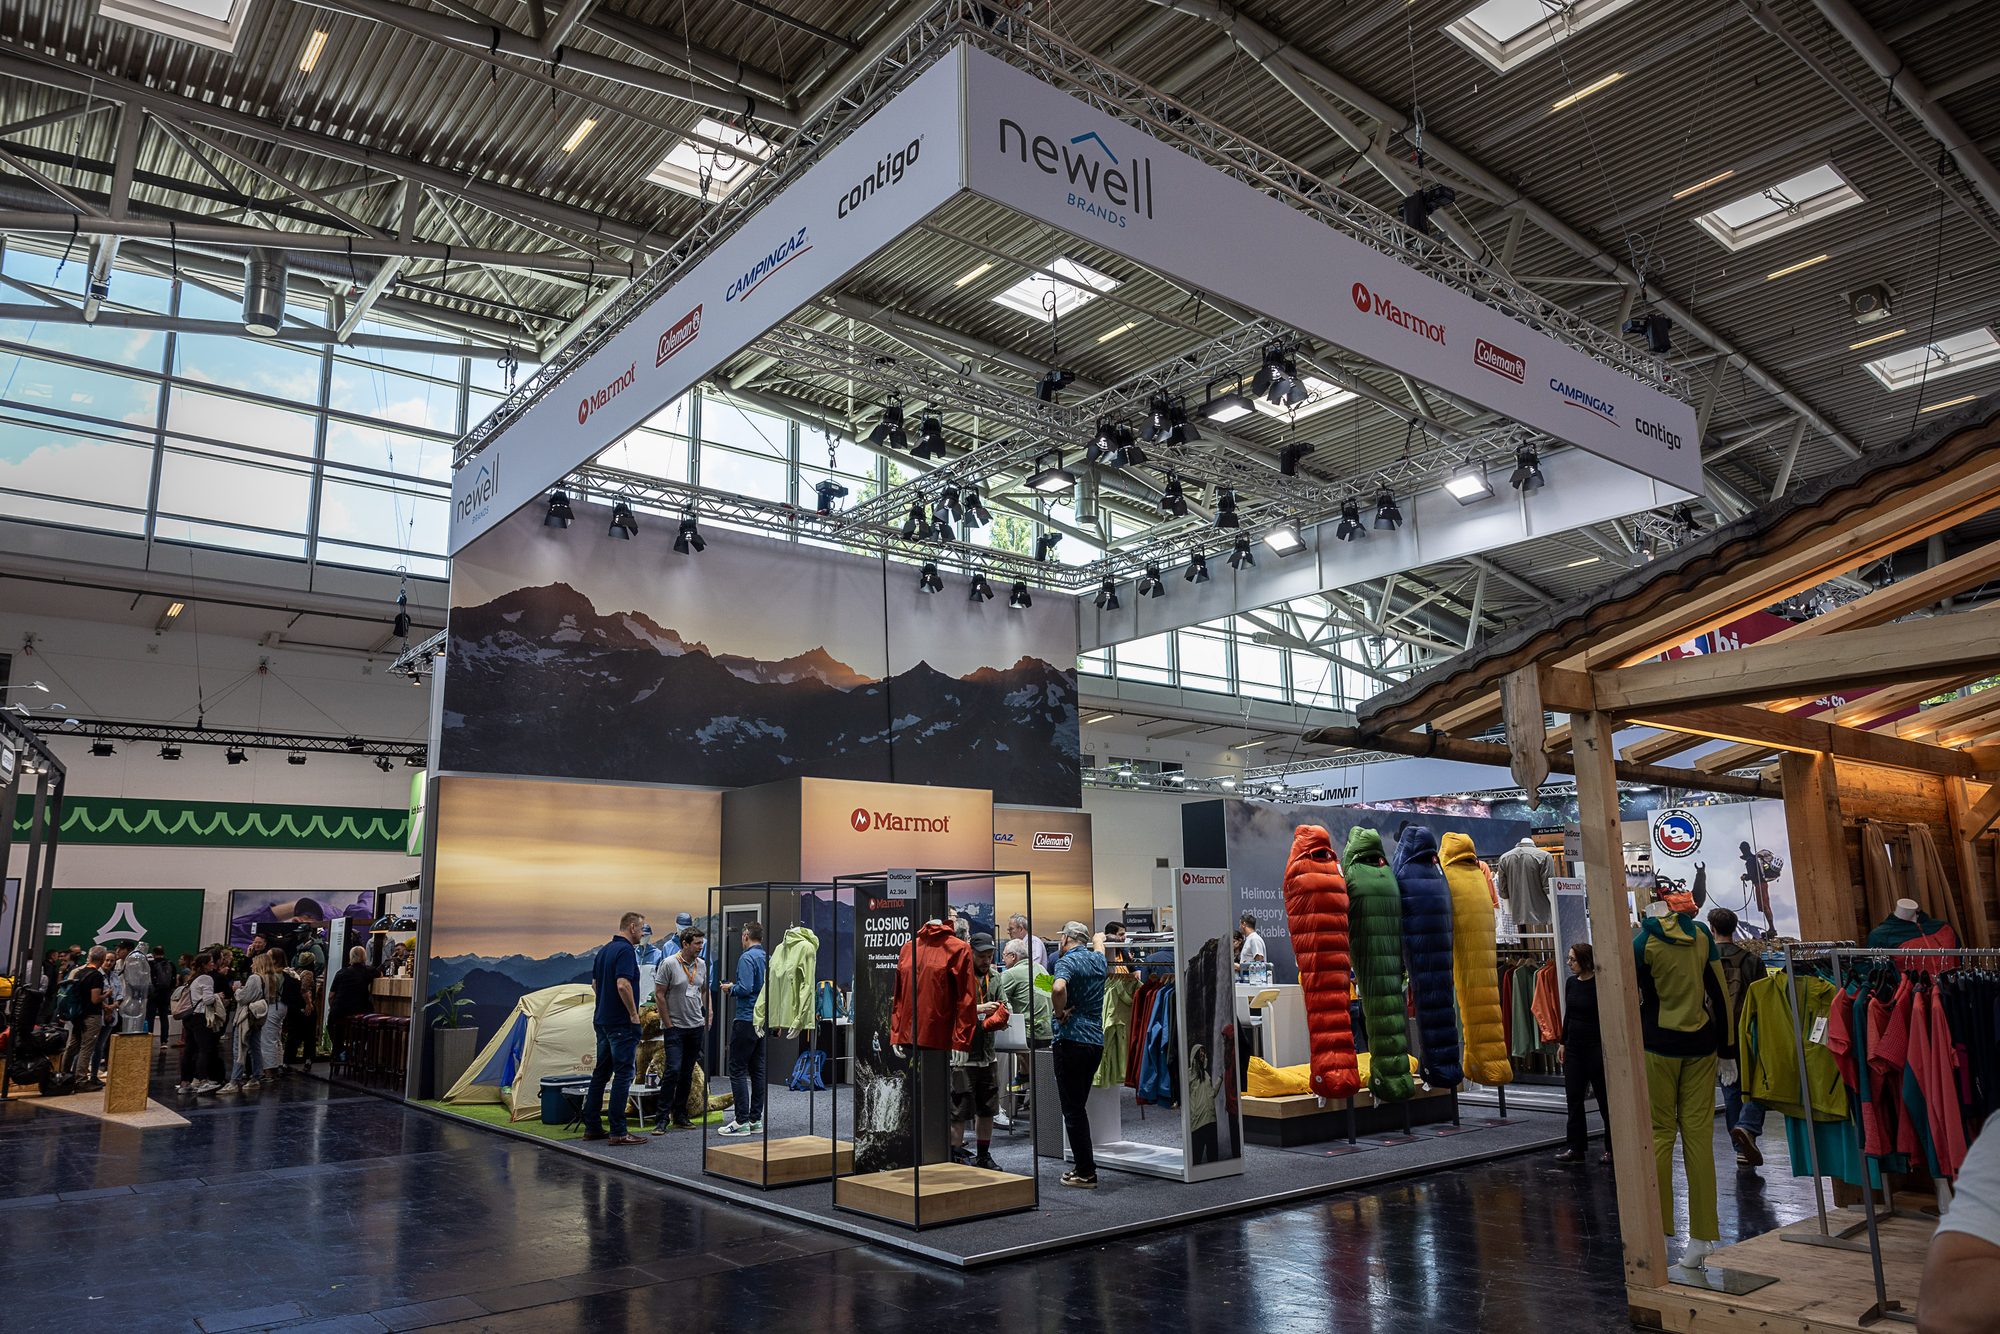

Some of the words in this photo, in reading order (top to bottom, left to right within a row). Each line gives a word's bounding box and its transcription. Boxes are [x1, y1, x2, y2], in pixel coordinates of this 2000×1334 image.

[1000, 118, 1153, 220] newell
[1066, 192, 1127, 229] BRANDS
[725, 226, 808, 302] CAMPINGAZ
[1373, 292, 1447, 346] Marmot
[659, 320, 693, 358] Coleman
[1477, 342, 1516, 374] Coleman
[589, 361, 637, 416] Marmot
[1549, 378, 1616, 417] CAMPINGAZ
[1635, 417, 1682, 451] contigo
[456, 452, 500, 524] newell
[1713, 628, 1750, 651] bi
[873, 811, 950, 833] Marmot
[1036, 834, 1064, 846] Coleman
[1191, 874, 1225, 885] Marmot
[1240, 887, 1276, 900] Helinox
[1562, 882, 1582, 890] Marmot
[863, 933, 884, 948] THE
[884, 932, 912, 947] LOOP
[865, 916, 910, 932] CLOSING
